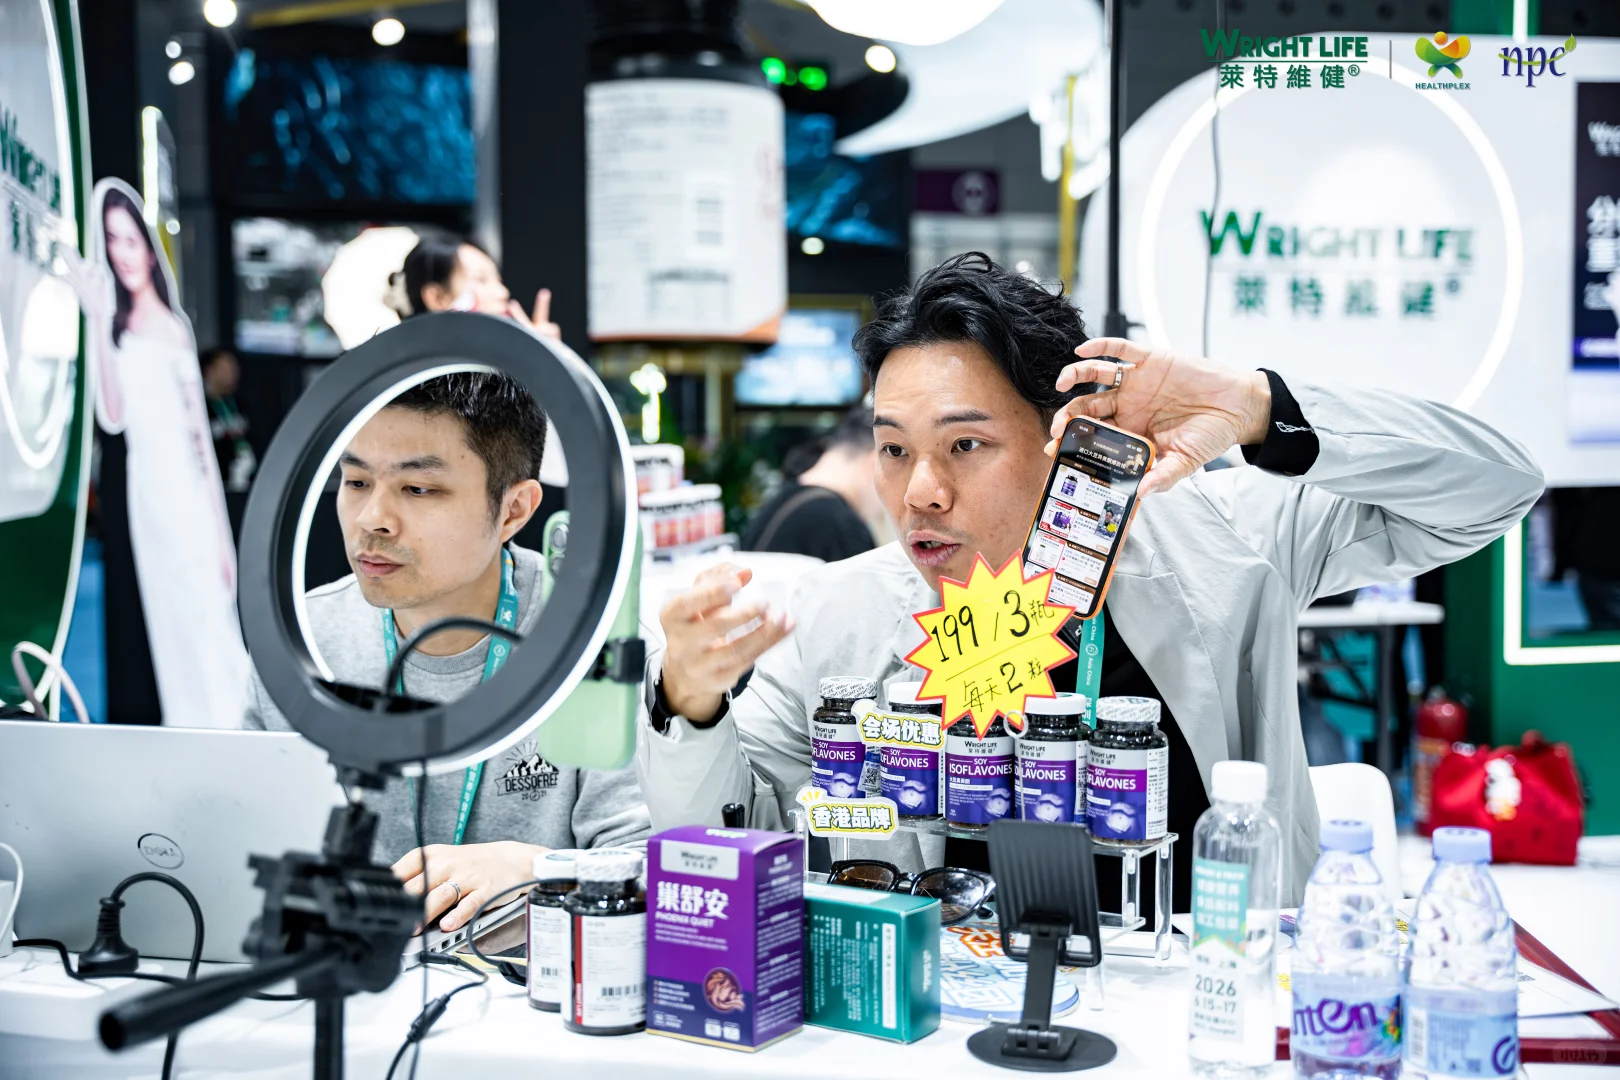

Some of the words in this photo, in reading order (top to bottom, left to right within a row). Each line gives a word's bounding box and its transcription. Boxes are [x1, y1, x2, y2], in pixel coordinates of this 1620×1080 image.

[1200, 210, 1381, 257] WRIGHT
[1398, 229, 1472, 259] LIFE
[862, 715, 941, 746] 会场优惠
[818, 741, 829, 749] SOY
[949, 763, 1013, 776] ISOFLAVONES
[1014, 766, 1066, 780] OLAVONES
[1094, 768, 1106, 776] SOY
[812, 805, 892, 830] 香港品牌
[656, 880, 729, 920] 巢舒安
[1195, 975, 1237, 997] 2026
